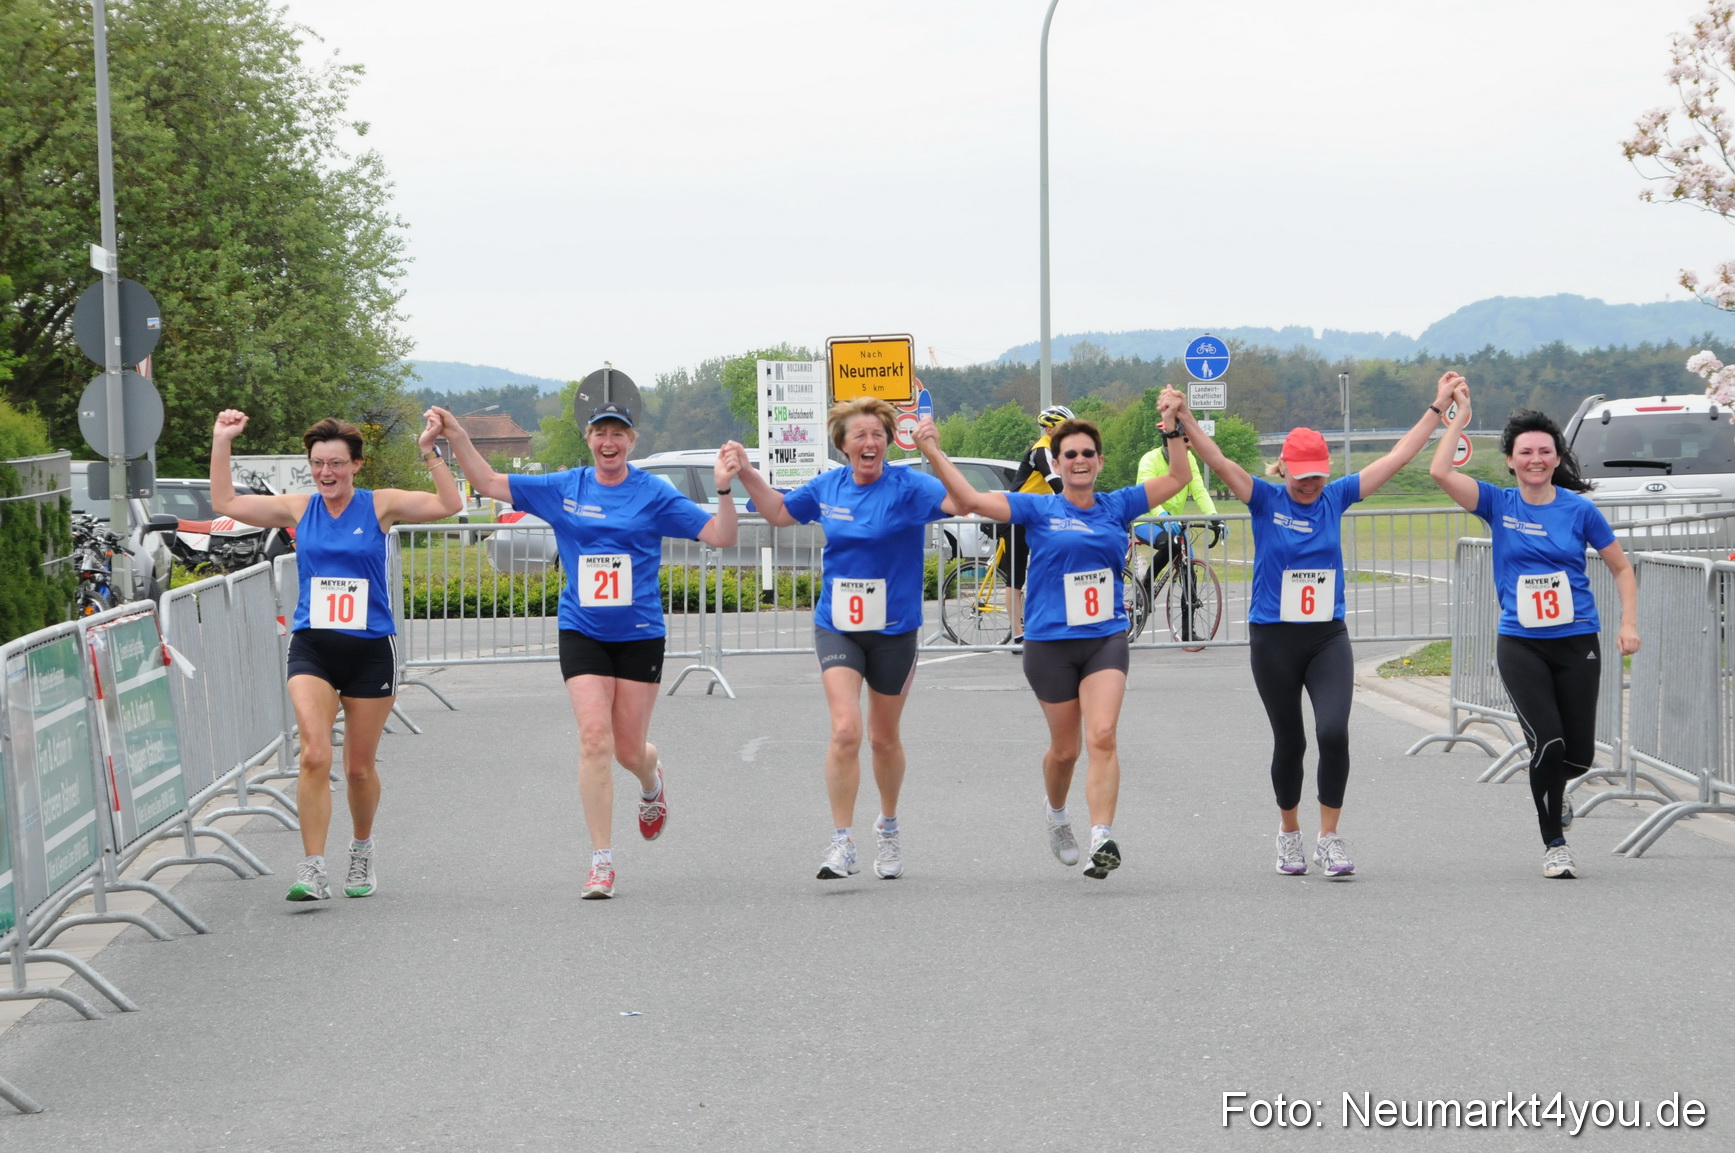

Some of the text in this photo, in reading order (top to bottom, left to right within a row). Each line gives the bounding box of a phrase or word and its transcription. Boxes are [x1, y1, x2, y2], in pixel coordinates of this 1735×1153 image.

[860, 350, 883, 358] Nach
[839, 361, 904, 378] Neumarkt
[861, 383, 885, 392] 5 km
[774, 406, 788, 421] SHB
[775, 448, 797, 463] THULE
[594, 570, 618, 599] 21
[1074, 573, 1098, 581] MEYER
[327, 593, 354, 623] 10
[850, 595, 863, 624] 9
[1084, 587, 1099, 616] 8
[1301, 585, 1315, 615] 6
[1532, 589, 1560, 619] 13
